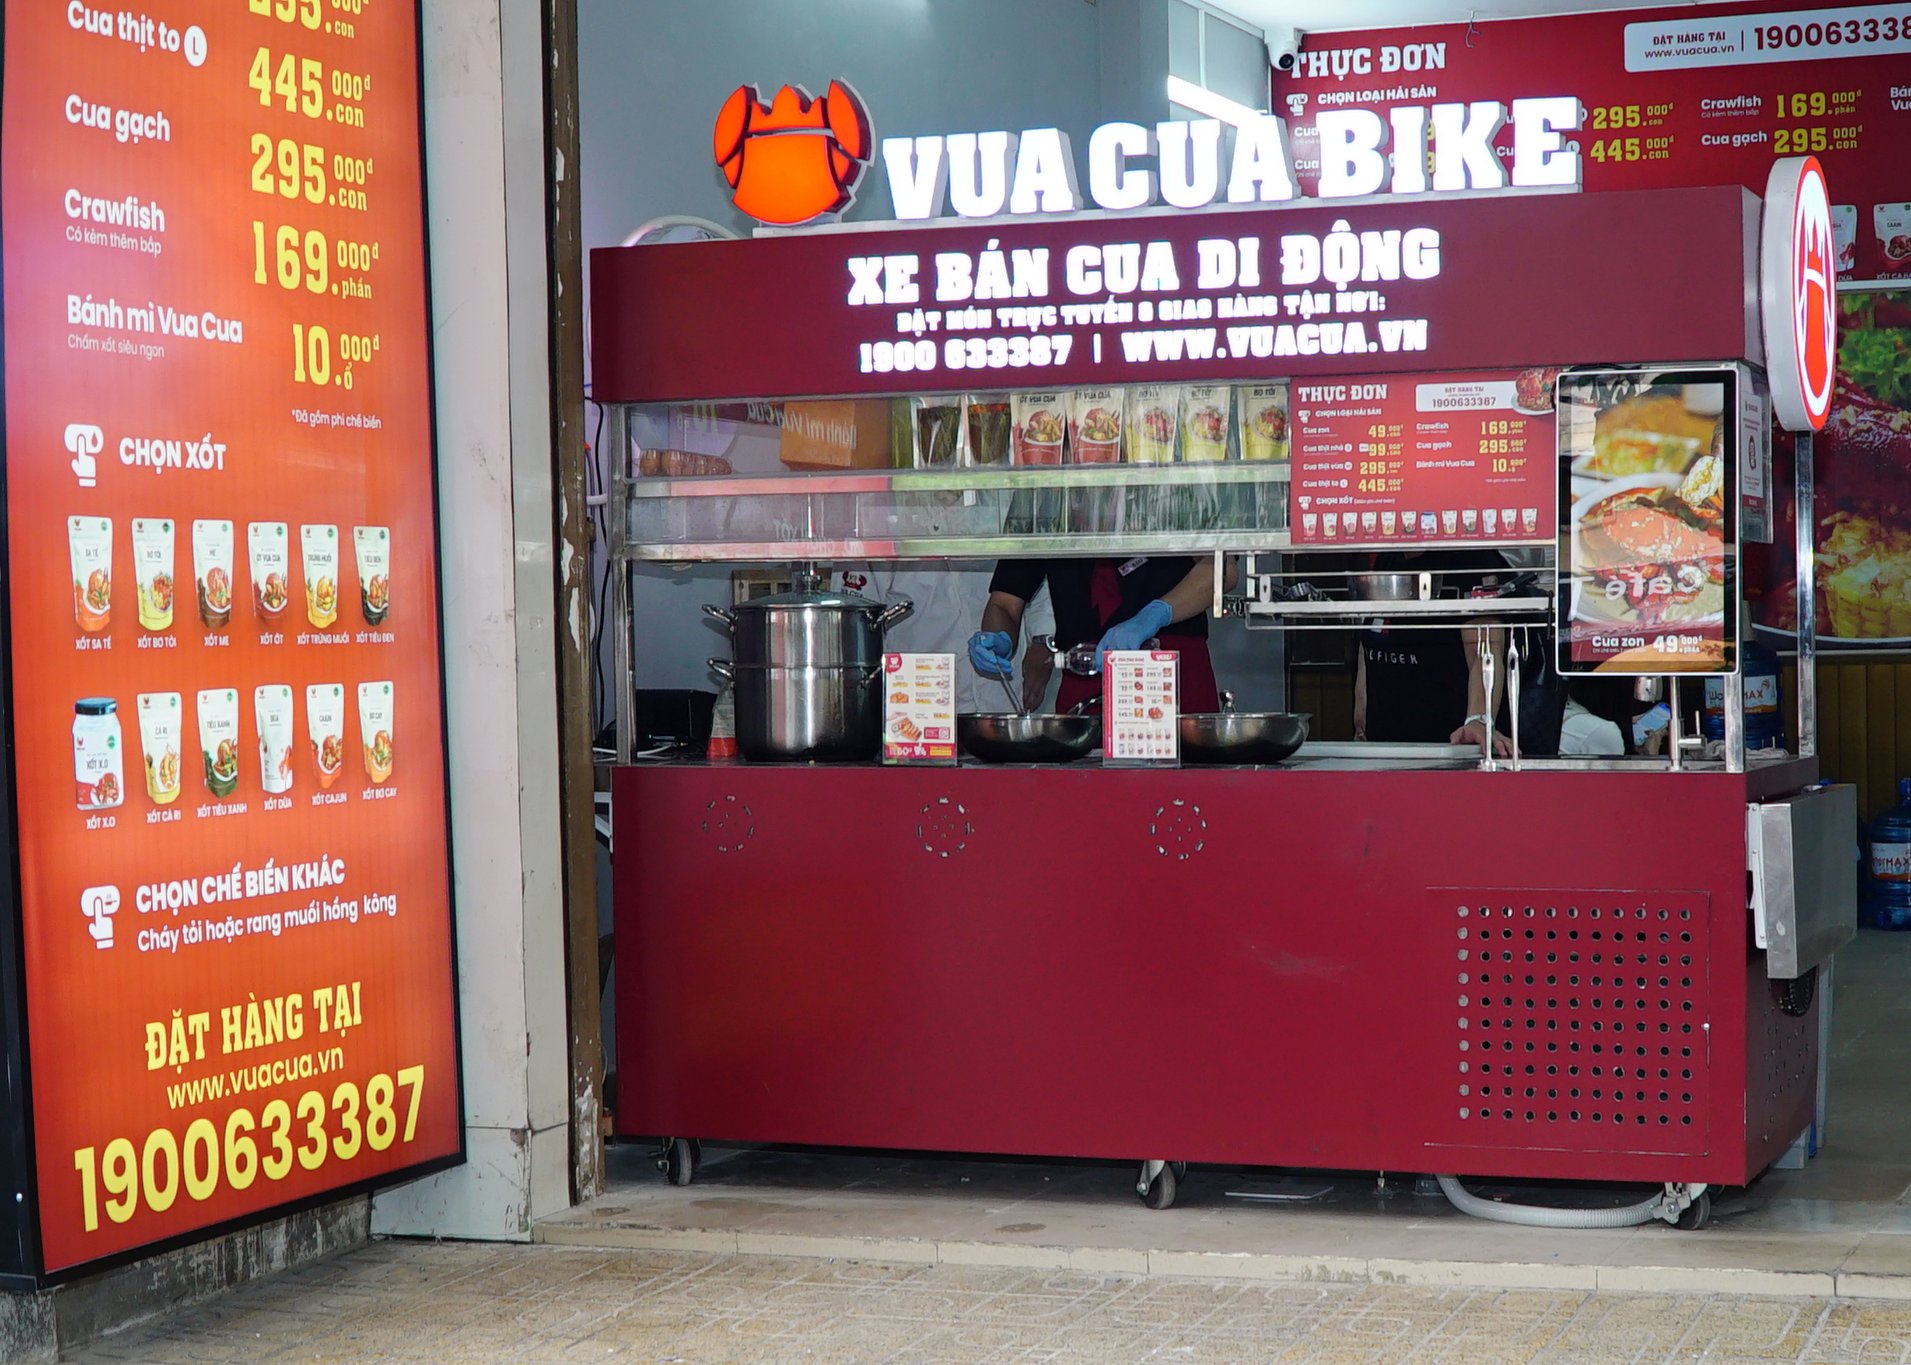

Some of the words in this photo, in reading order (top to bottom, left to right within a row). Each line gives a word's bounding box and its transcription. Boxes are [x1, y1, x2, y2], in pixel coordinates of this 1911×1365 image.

[67, 0, 113, 37] Cua
[117, 11, 155, 53] thịt
[158, 21, 180, 52] to
[334, 20, 355, 39] con
[1652, 34, 1674, 48] ĐẶT
[1677, 32, 1705, 44] HÀNG
[1708, 31, 1726, 44] TẠI
[1644, 43, 1735, 59] www.vuacua.vn
[1291, 47, 1372, 81] THỰC
[1379, 42, 1447, 73] ĐƠN
[1317, 91, 1355, 106] CHỌN
[1356, 90, 1385, 104] LOẠI
[1386, 86, 1409, 100] HẢI
[1410, 84, 1437, 98] SẢN
[1701, 95, 1762, 110] Crawfish
[65, 94, 111, 130] Cua
[115, 110, 171, 144] gạch
[335, 103, 365, 128] con
[1294, 126, 1319, 137] Cua
[1701, 134, 1730, 146] Cua
[1732, 130, 1768, 148] gạch
[1836, 139, 1858, 150] con
[882, 127, 1080, 221] VUA
[1088, 114, 1298, 210] CUA
[1315, 96, 1580, 198] BIKE
[1295, 159, 1320, 170] Cua
[1649, 149, 1669, 161] con
[338, 187, 368, 211] con
[65, 188, 165, 232] Crawfish
[65, 225, 82, 243] Có
[84, 227, 109, 247] kèm
[110, 233, 139, 251] thêm
[847, 255, 920, 306] XE
[935, 238, 1050, 302] BÁN
[1065, 241, 1180, 296] CUA
[1197, 237, 1260, 289] DI
[1280, 219, 1441, 292] ĐỘNG
[67, 293, 124, 329] Bánh
[157, 306, 199, 338] Vua
[201, 311, 243, 344] Cua
[1158, 299, 1212, 321] GIAO
[67, 333, 100, 351] Chấm
[118, 338, 138, 355] siêu
[140, 345, 165, 361] ngon
[859, 340, 937, 374] 1900
[944, 334, 1073, 370] 633387
[1120, 319, 1429, 363] WWW.VUACUA.VN
[1298, 385, 1347, 404] THỰC
[1350, 384, 1388, 401] ĐƠN
[1432, 397, 1497, 408] 1900633387
[119, 437, 182, 475] CHỌN
[185, 432, 227, 471] XỐT
[75, 635, 90, 650] XỐT
[91, 638, 101, 650] SA
[137, 634, 151, 649] XỐT
[204, 633, 218, 647] XỐT
[218, 636, 229, 647] ME
[260, 632, 273, 645] XỐT
[1592, 635, 1619, 647] Cua
[1621, 636, 1645, 647] zon
[264, 797, 277, 811] XỐT
[311, 792, 325, 806] XỐT
[146, 809, 161, 824] XỐT
[197, 805, 211, 819] XỐT
[86, 815, 101, 830] XỐT
[102, 816, 116, 829] X.O
[135, 879, 198, 916] CHỌN
[201, 861, 243, 904] CHẾ
[245, 857, 289, 898] BIẾN
[292, 853, 346, 891] KHÁC
[137, 924, 180, 954] Cháy
[182, 920, 203, 945] tỏi
[205, 915, 244, 944] hoặc
[246, 911, 282, 937] rang
[284, 899, 321, 929] muối
[323, 896, 358, 924] hồng
[363, 892, 397, 917] kông
[144, 1007, 211, 1074] ĐẶT
[220, 992, 303, 1056] HÀNG
[312, 981, 363, 1037] TẠI
[166, 1046, 345, 1111] www.vuacua.vn
[73, 1064, 425, 1233] 1900633387
